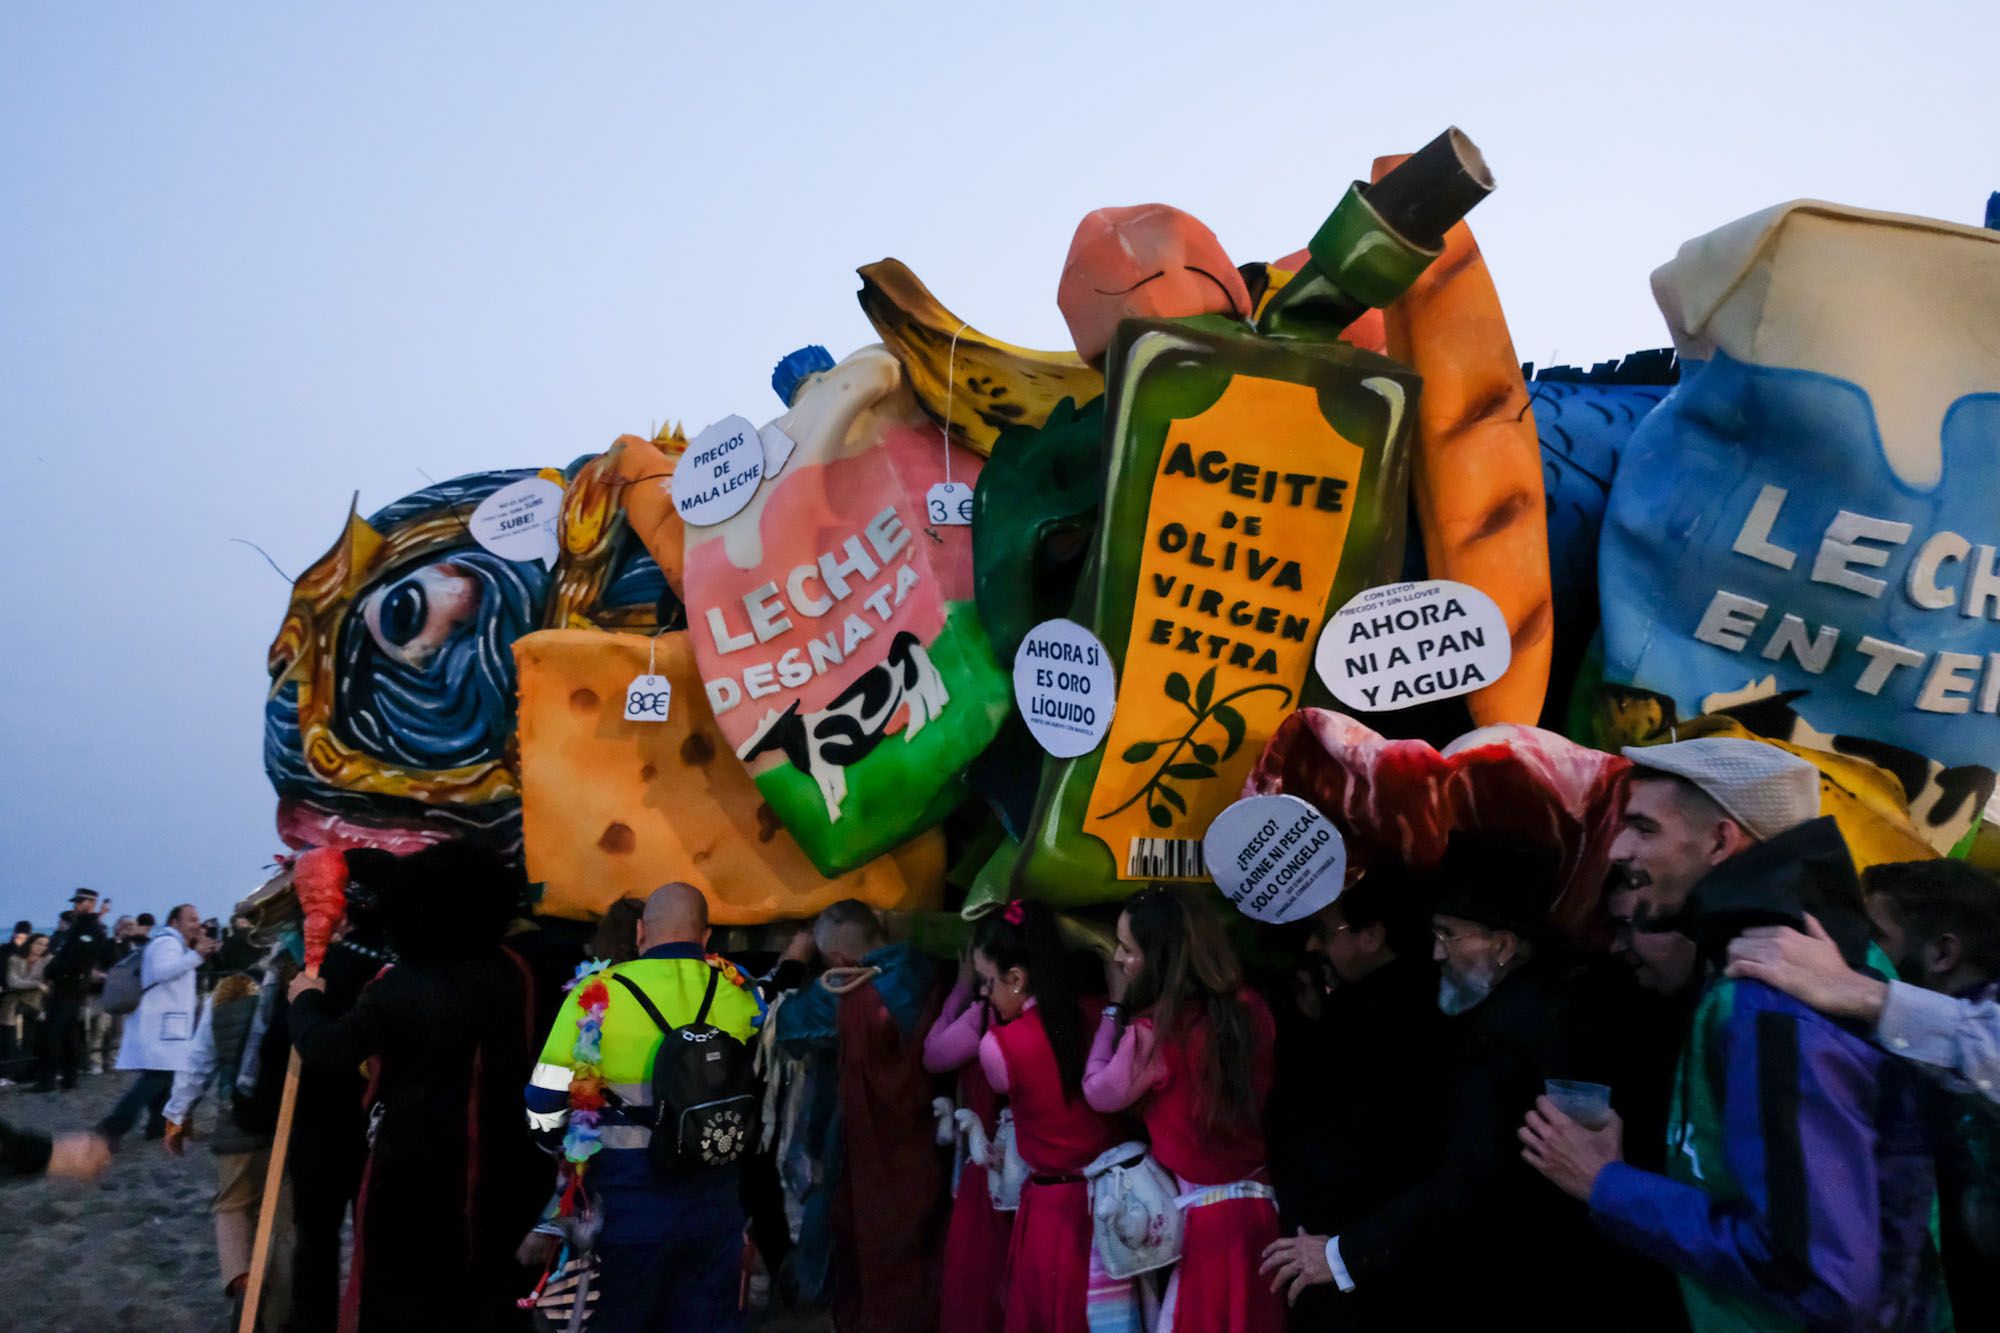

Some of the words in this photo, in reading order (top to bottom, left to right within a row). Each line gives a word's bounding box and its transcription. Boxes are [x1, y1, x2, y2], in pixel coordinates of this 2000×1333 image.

[693, 433, 744, 468] PRECIOS
[714, 461, 730, 478] DE
[680, 487, 720, 512] MALA
[723, 464, 760, 494] LECHE
[1164, 443, 1348, 513] ACEITE
[500, 512, 535, 531] SUBE!
[931, 499, 948, 522] 3
[1220, 511, 1262, 536] DE
[705, 505, 912, 656] LECHE
[1158, 523, 1303, 592] OLIVA
[1153, 573, 1310, 643] VIRGEN
[1340, 603, 1377, 616] PRECIOS
[1387, 597, 1402, 606] SIN
[1404, 587, 1440, 602] LLOVER
[1364, 591, 1384, 602] CON
[1387, 584, 1415, 595] ESTOS
[704, 564, 920, 716] DESNATA
[1348, 598, 1467, 644] AHORA
[1026, 640, 1083, 664] AHORA
[1150, 618, 1278, 674] EXTRA
[1345, 653, 1378, 678] NI
[1387, 647, 1411, 669] A
[1417, 627, 1485, 661] PAN
[1694, 590, 2000, 714] ENTE
[1037, 669, 1053, 688] ES
[1057, 672, 1091, 694] ORO
[1361, 685, 1380, 707] Y
[1391, 663, 1486, 703] AGUA
[1031, 694, 1095, 726] LÍQUIDO
[1237, 819, 1279, 871] ¿FRESCO?
[1240, 857, 1274, 894] CARNE
[1268, 846, 1285, 862] NI
[1251, 883, 1279, 912] SOLO
[1275, 829, 1330, 886] CONGELAO
